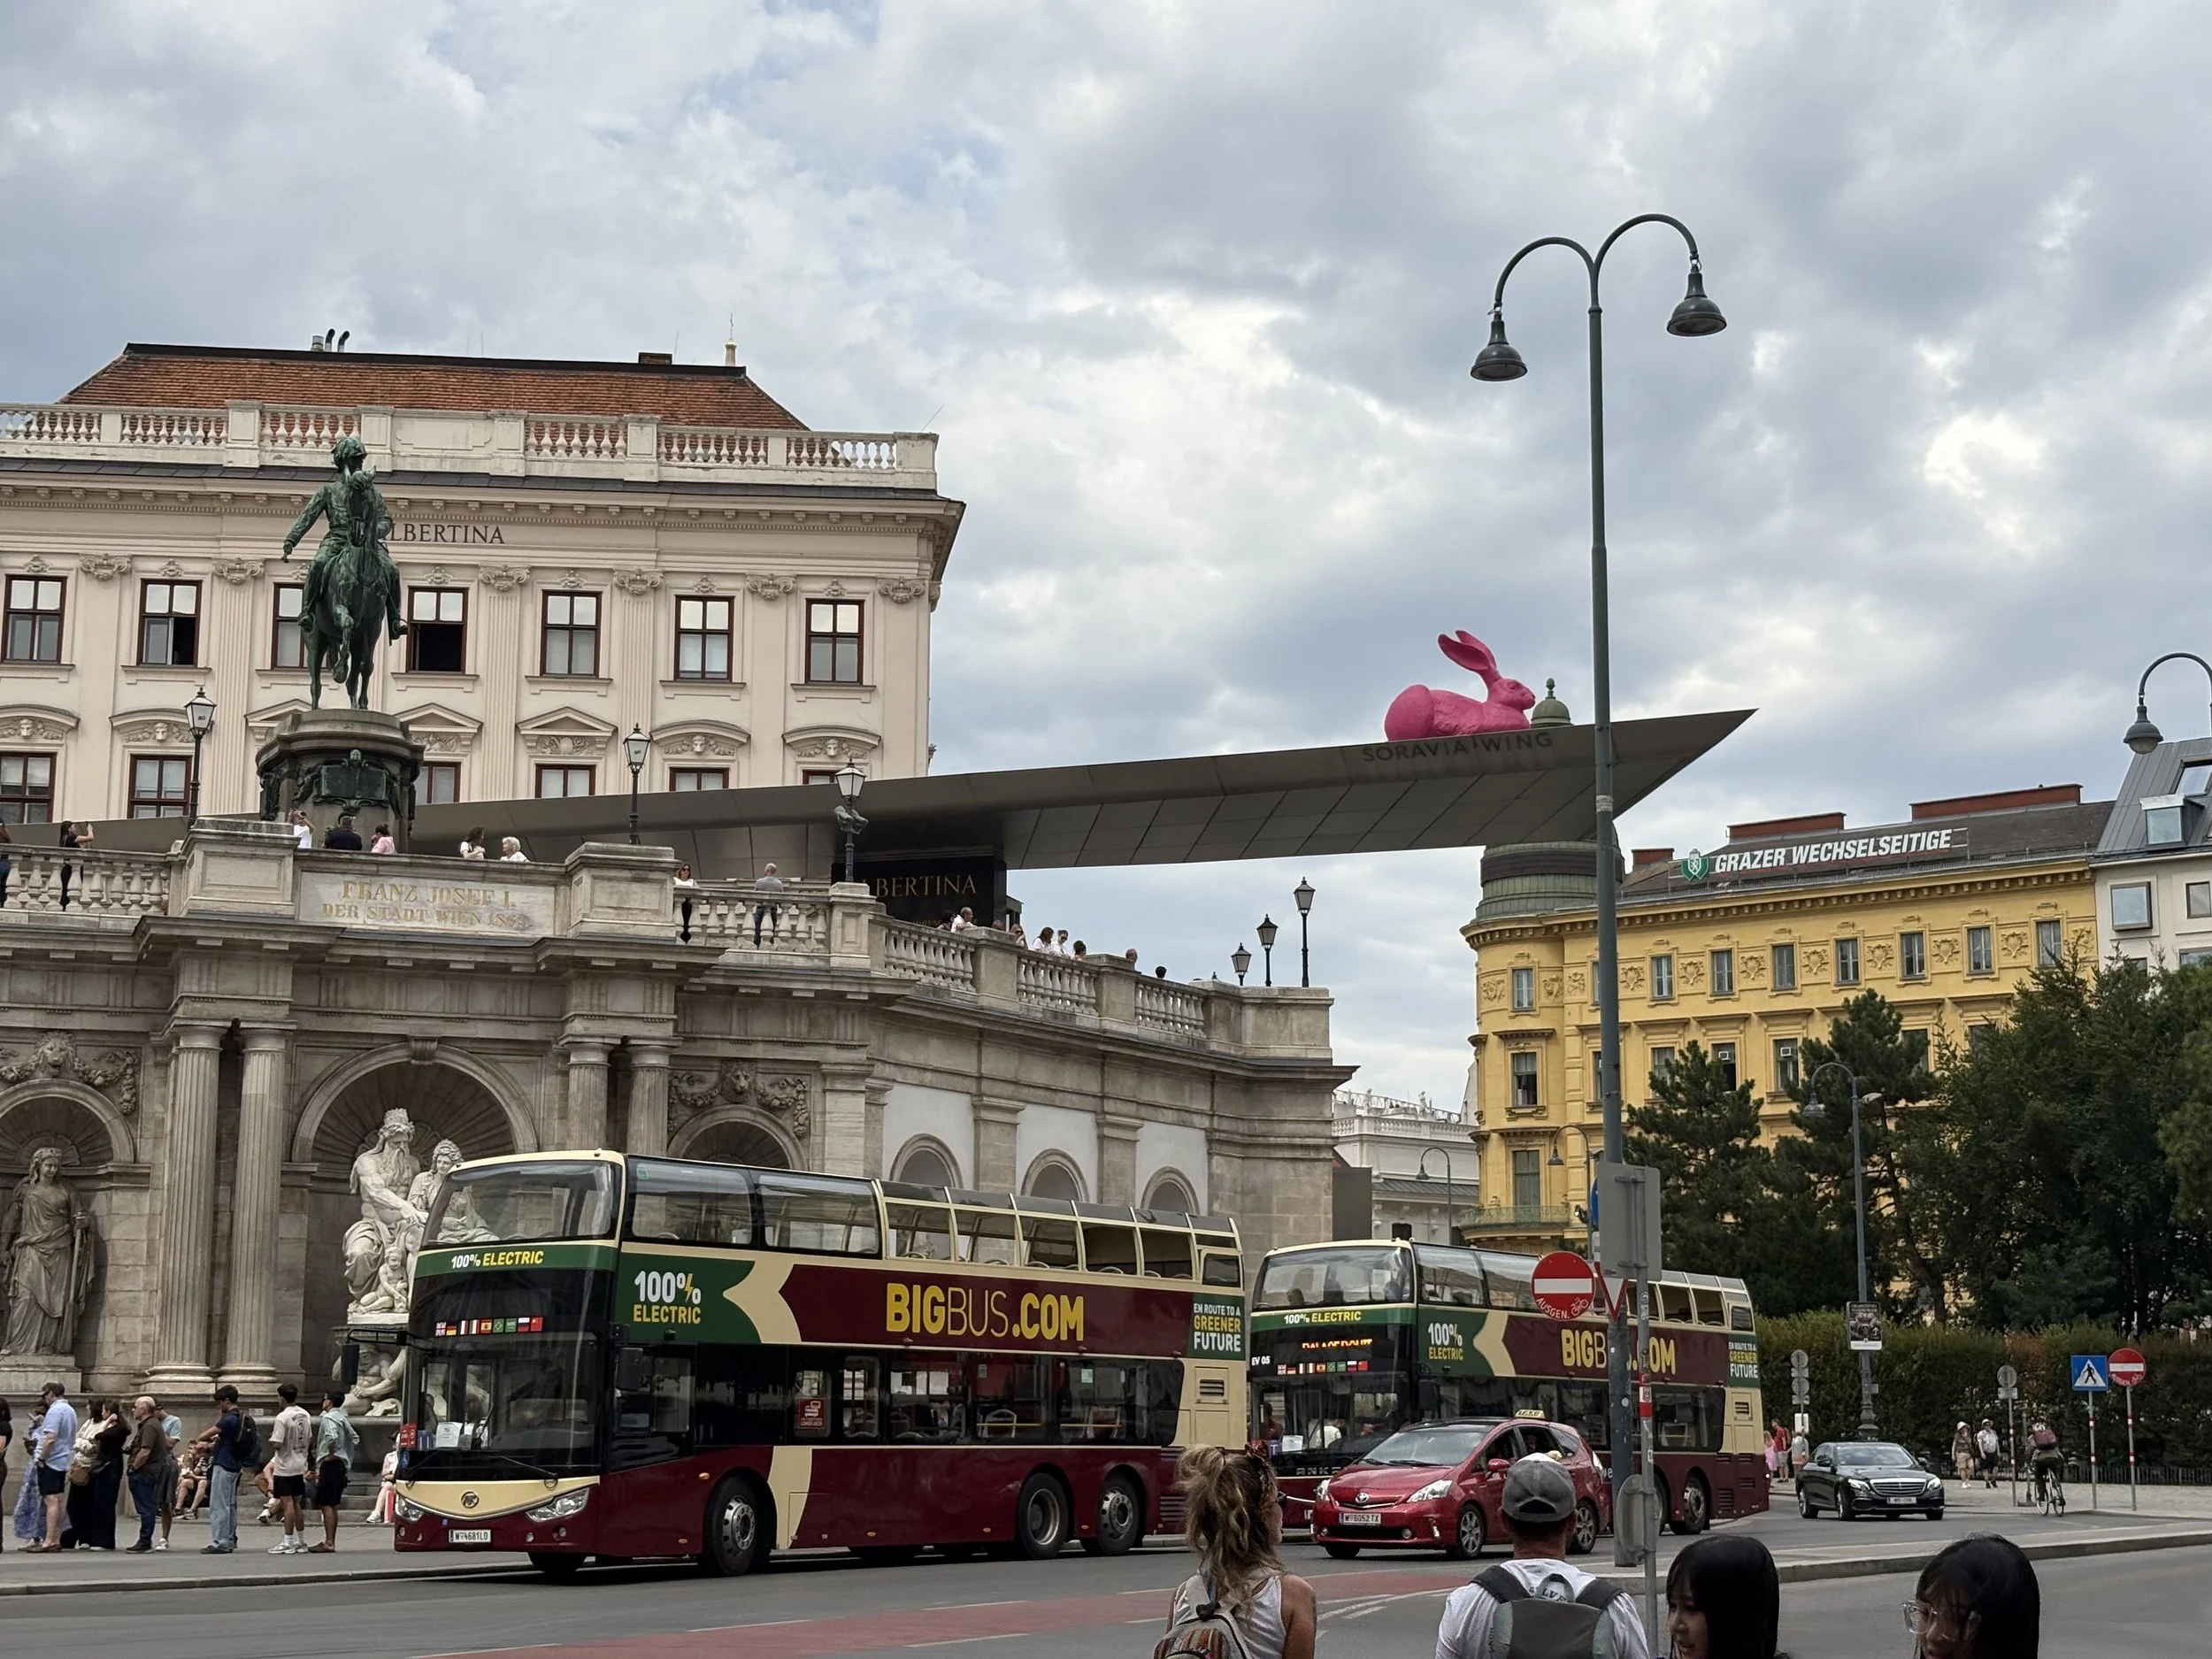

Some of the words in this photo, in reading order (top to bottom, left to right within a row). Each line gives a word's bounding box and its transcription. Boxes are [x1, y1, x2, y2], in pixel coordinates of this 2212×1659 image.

[384, 523, 505, 544] LBERTINA
[1363, 739, 1470, 763] SORAVIA
[1479, 732, 1554, 752] WING
[1715, 847, 1786, 873] GRAZER
[1792, 828, 1953, 863] WECHSELSEITIGE
[342, 879, 418, 902] FRANZ
[426, 886, 495, 907] JOSEF
[321, 903, 358, 918] DER
[366, 905, 428, 923] STADT
[435, 909, 481, 926] WIEN
[450, 1255, 480, 1269] 100%
[482, 1250, 544, 1266] ELECTRIC
[634, 1271, 702, 1304] 100%
[633, 1304, 702, 1325] ELECTRIC
[886, 1282, 1085, 1342] BIGBUS.COM
[1194, 1303, 1203, 1314] EN
[1204, 1304, 1225, 1316] ROUTE
[1226, 1306, 1235, 1317] TO
[1235, 1307, 1241, 1317] A
[1284, 1314, 1310, 1325] 100%
[1311, 1310, 1362, 1323] ELECTRIC
[1536, 1297, 1570, 1319] AUSGEN.
[1194, 1315, 1241, 1333] GREENER
[1428, 1322, 1463, 1346] 100%
[1194, 1332, 1241, 1352] FUTURE
[1252, 1357, 1260, 1366] EV
[1261, 1356, 1271, 1365] 05
[1429, 1348, 1463, 1361] ELECTRIC
[1730, 1363, 1759, 1379] FUTURE
